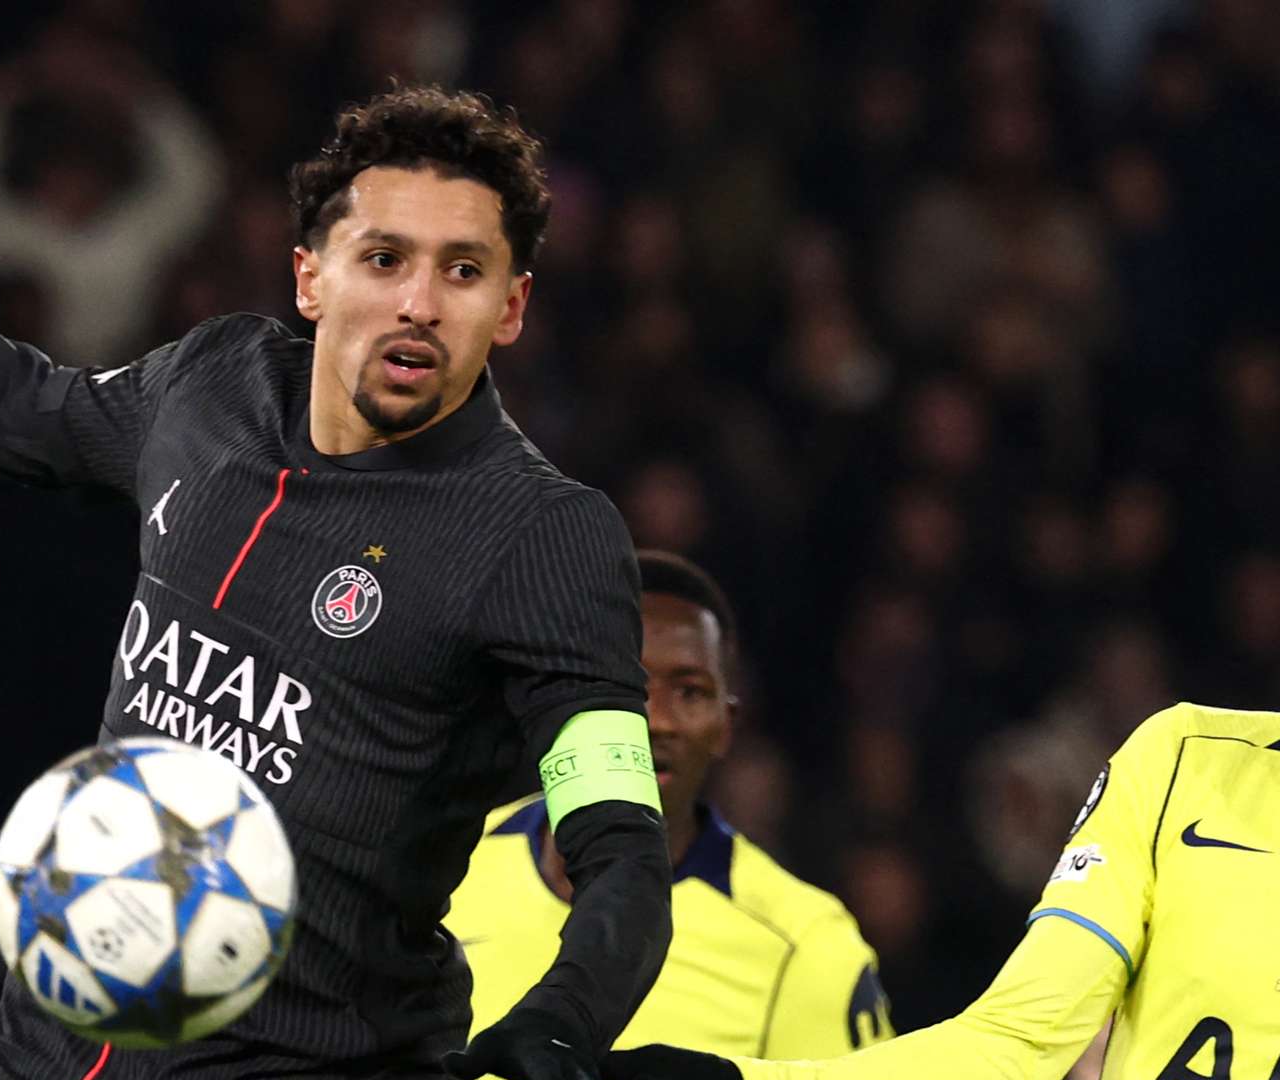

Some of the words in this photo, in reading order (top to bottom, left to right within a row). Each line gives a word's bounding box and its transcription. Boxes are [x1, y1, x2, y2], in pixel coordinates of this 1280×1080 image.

[339, 570, 377, 597] PARIS
[119, 600, 312, 745] QATAR
[124, 683, 297, 785] AIRWAYS
